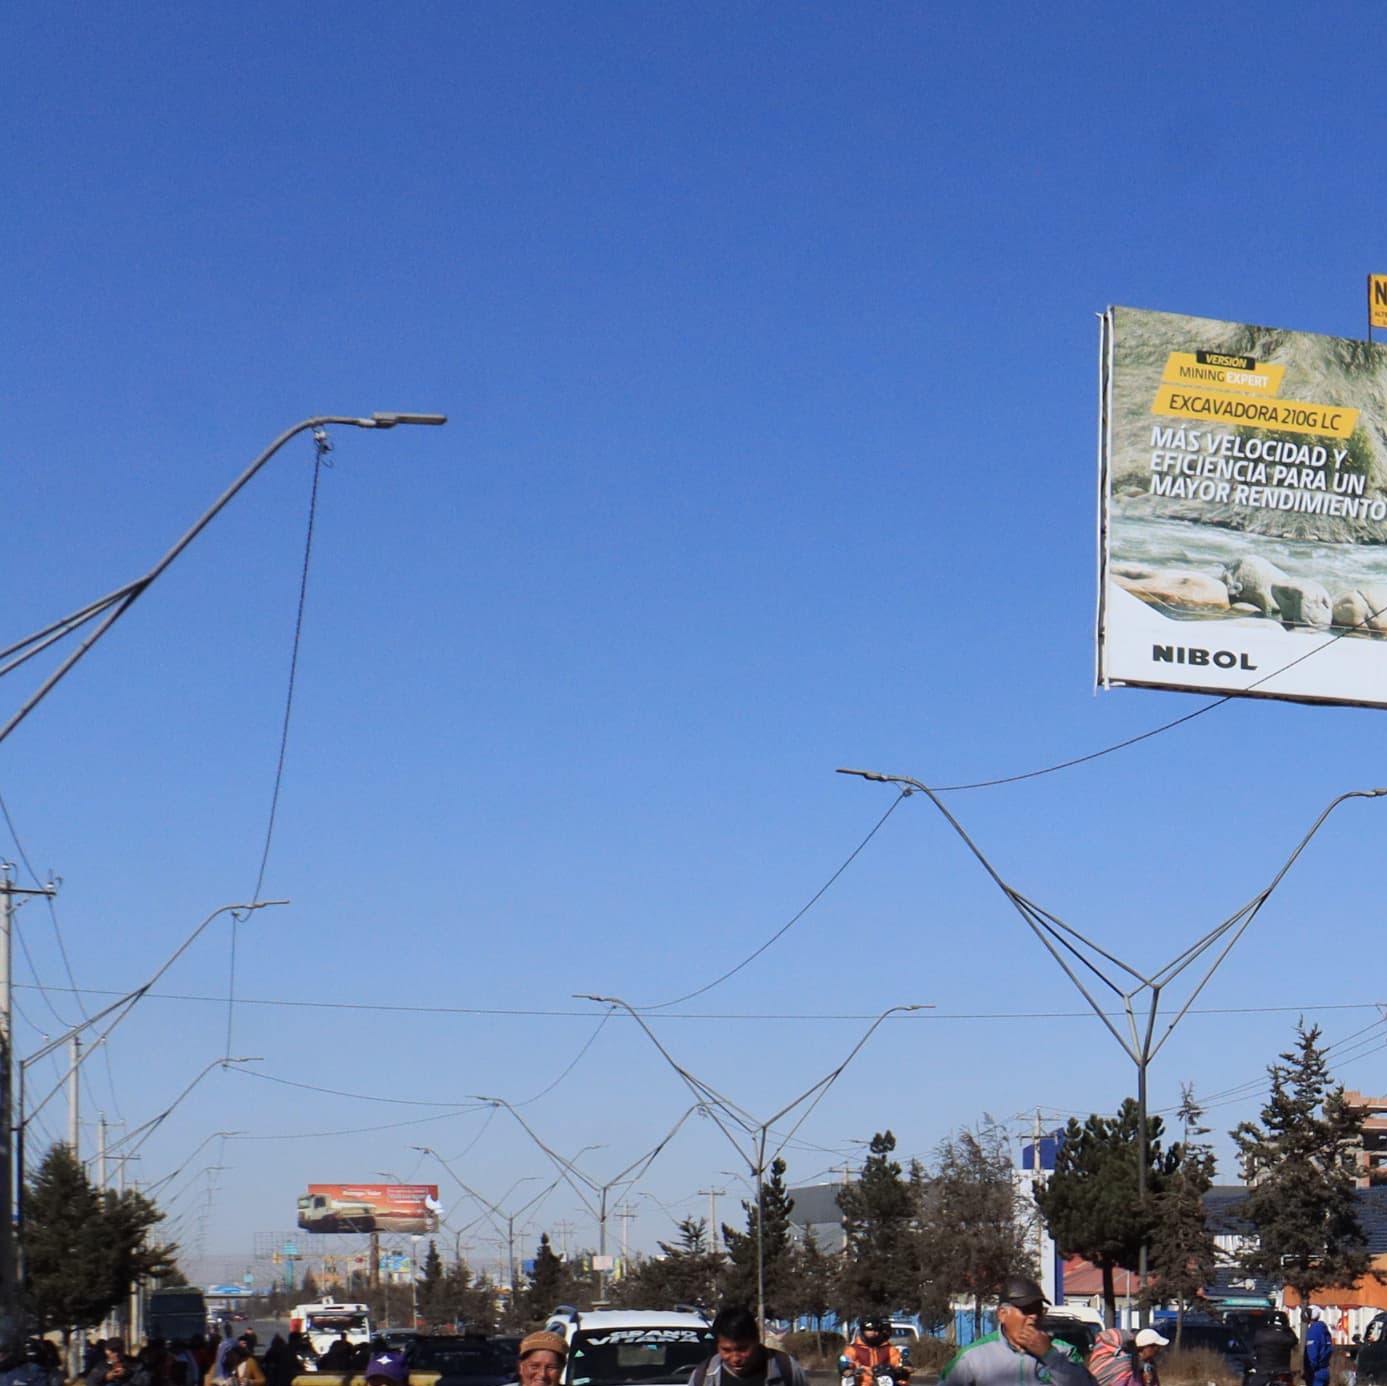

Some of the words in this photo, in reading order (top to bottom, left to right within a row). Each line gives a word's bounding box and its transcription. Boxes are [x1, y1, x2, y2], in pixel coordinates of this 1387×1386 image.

[1179, 366, 1225, 382] MINING
[1226, 373, 1269, 388] EXPERT
[1169, 394, 1279, 423] EXCAVADORA
[1281, 408, 1317, 428] 210G
[1321, 412, 1342, 431] LC
[1151, 424, 1201, 450] MÁS
[1207, 433, 1328, 467] VELOCIDAD
[1333, 449, 1348, 469] Y
[1151, 452, 1268, 485] EFICIENCIA
[1272, 465, 1327, 492] PARA
[1332, 474, 1366, 496] UN
[1150, 475, 1231, 504] MAYOR
[1235, 487, 1387, 522] RENDIMIENTO
[1152, 644, 1258, 671] NIBOL
